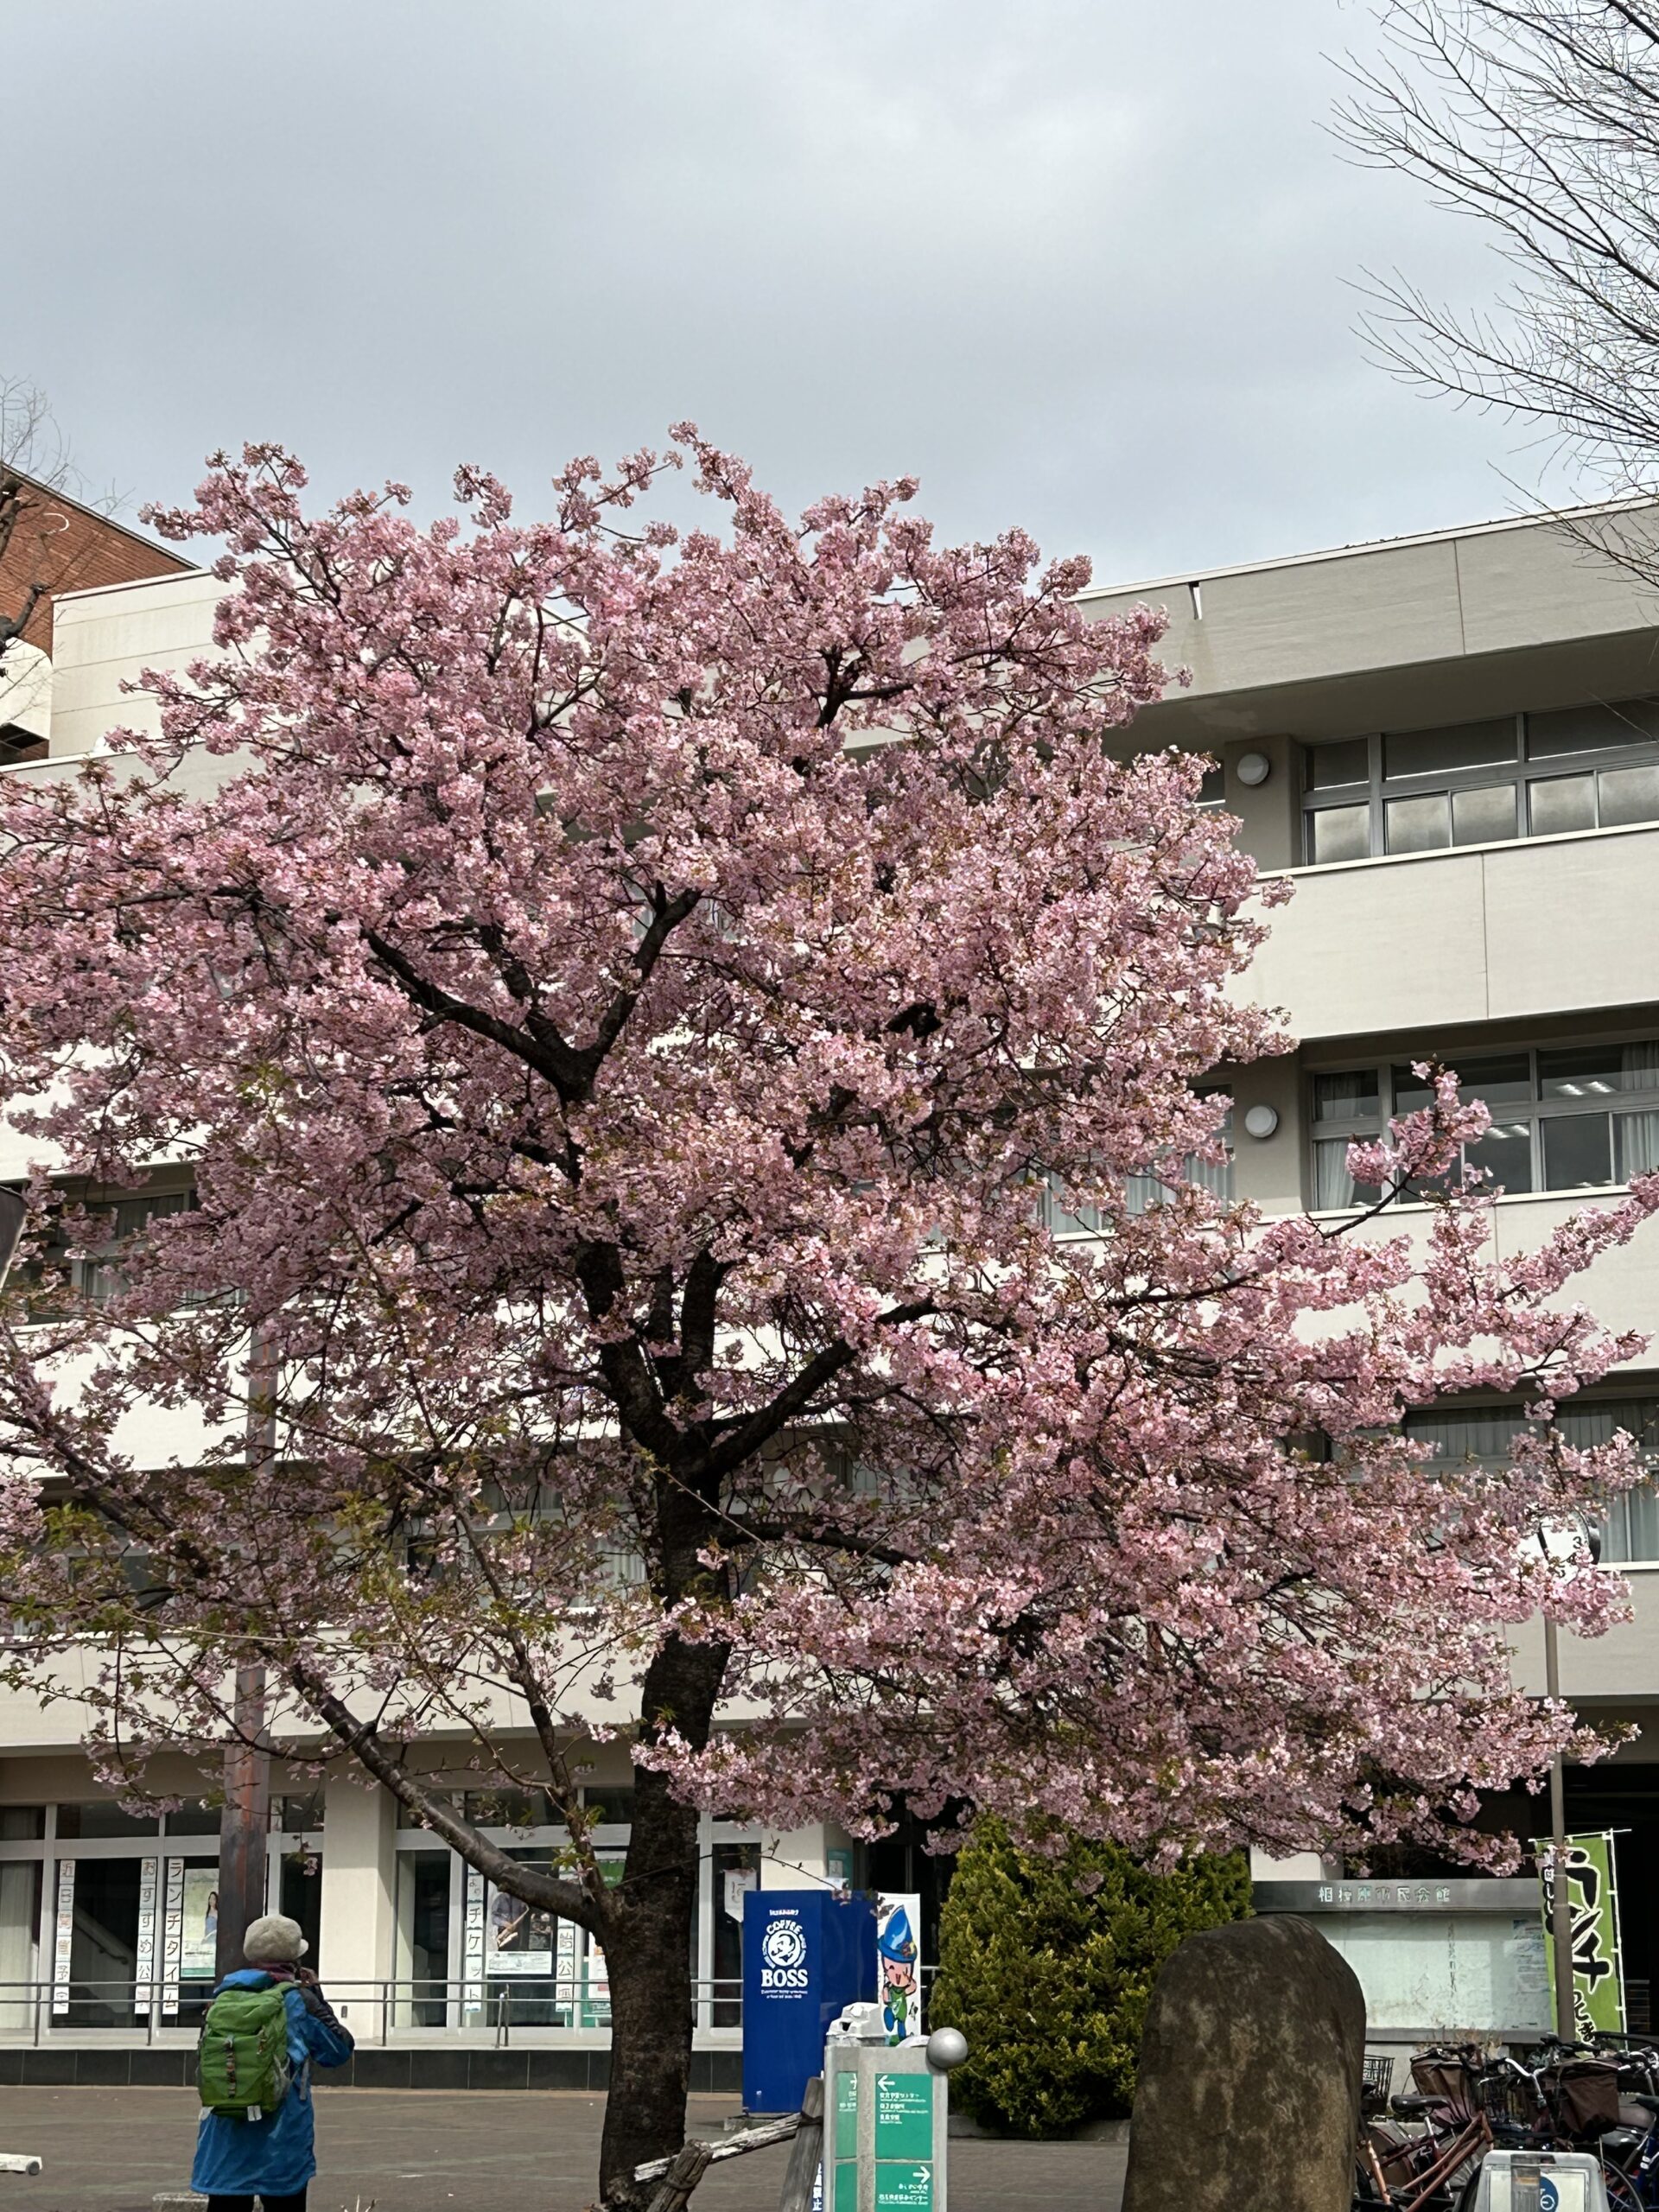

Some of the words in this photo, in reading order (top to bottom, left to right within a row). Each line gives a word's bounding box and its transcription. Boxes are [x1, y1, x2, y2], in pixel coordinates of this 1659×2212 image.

[1573, 1535, 1582, 1549] 3
[164, 1862, 182, 2008] ランチタイム
[760, 1968, 809, 1987] BOSS
